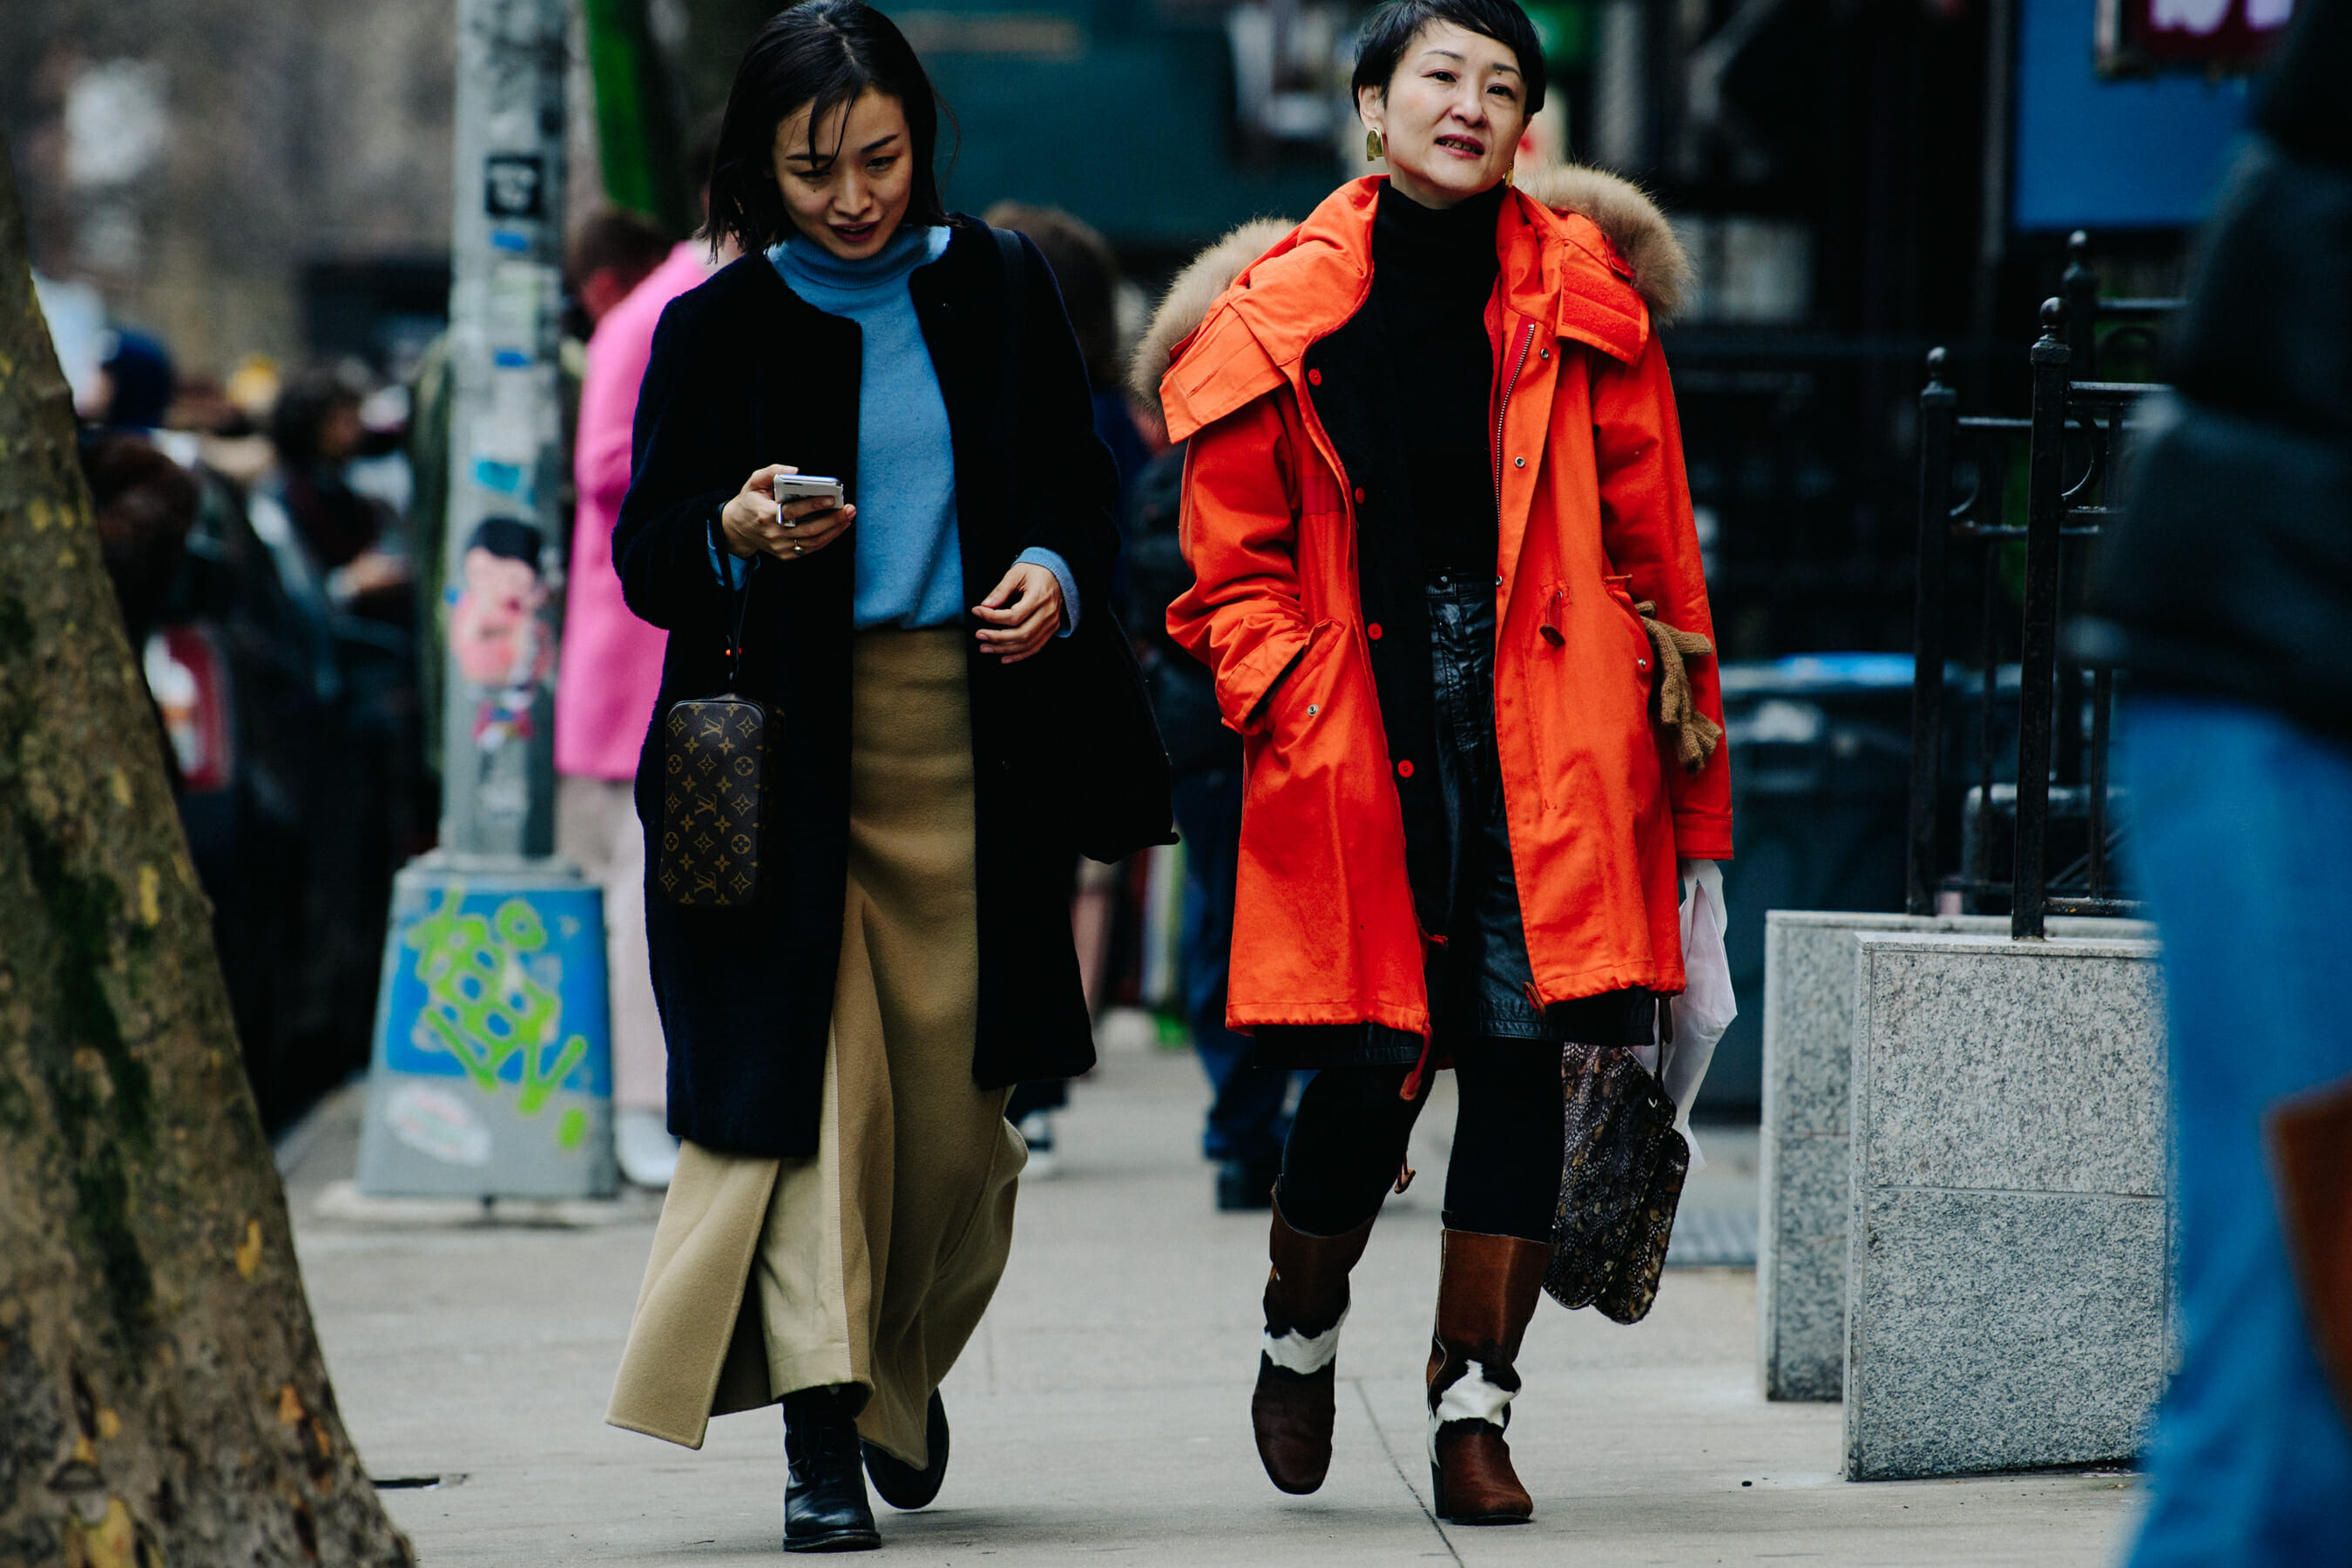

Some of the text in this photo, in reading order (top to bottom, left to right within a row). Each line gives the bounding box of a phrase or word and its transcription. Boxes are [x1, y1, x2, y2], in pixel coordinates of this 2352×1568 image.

[700, 714, 725, 738] LV
[694, 793, 717, 816] LV
[694, 871, 717, 895] LV
